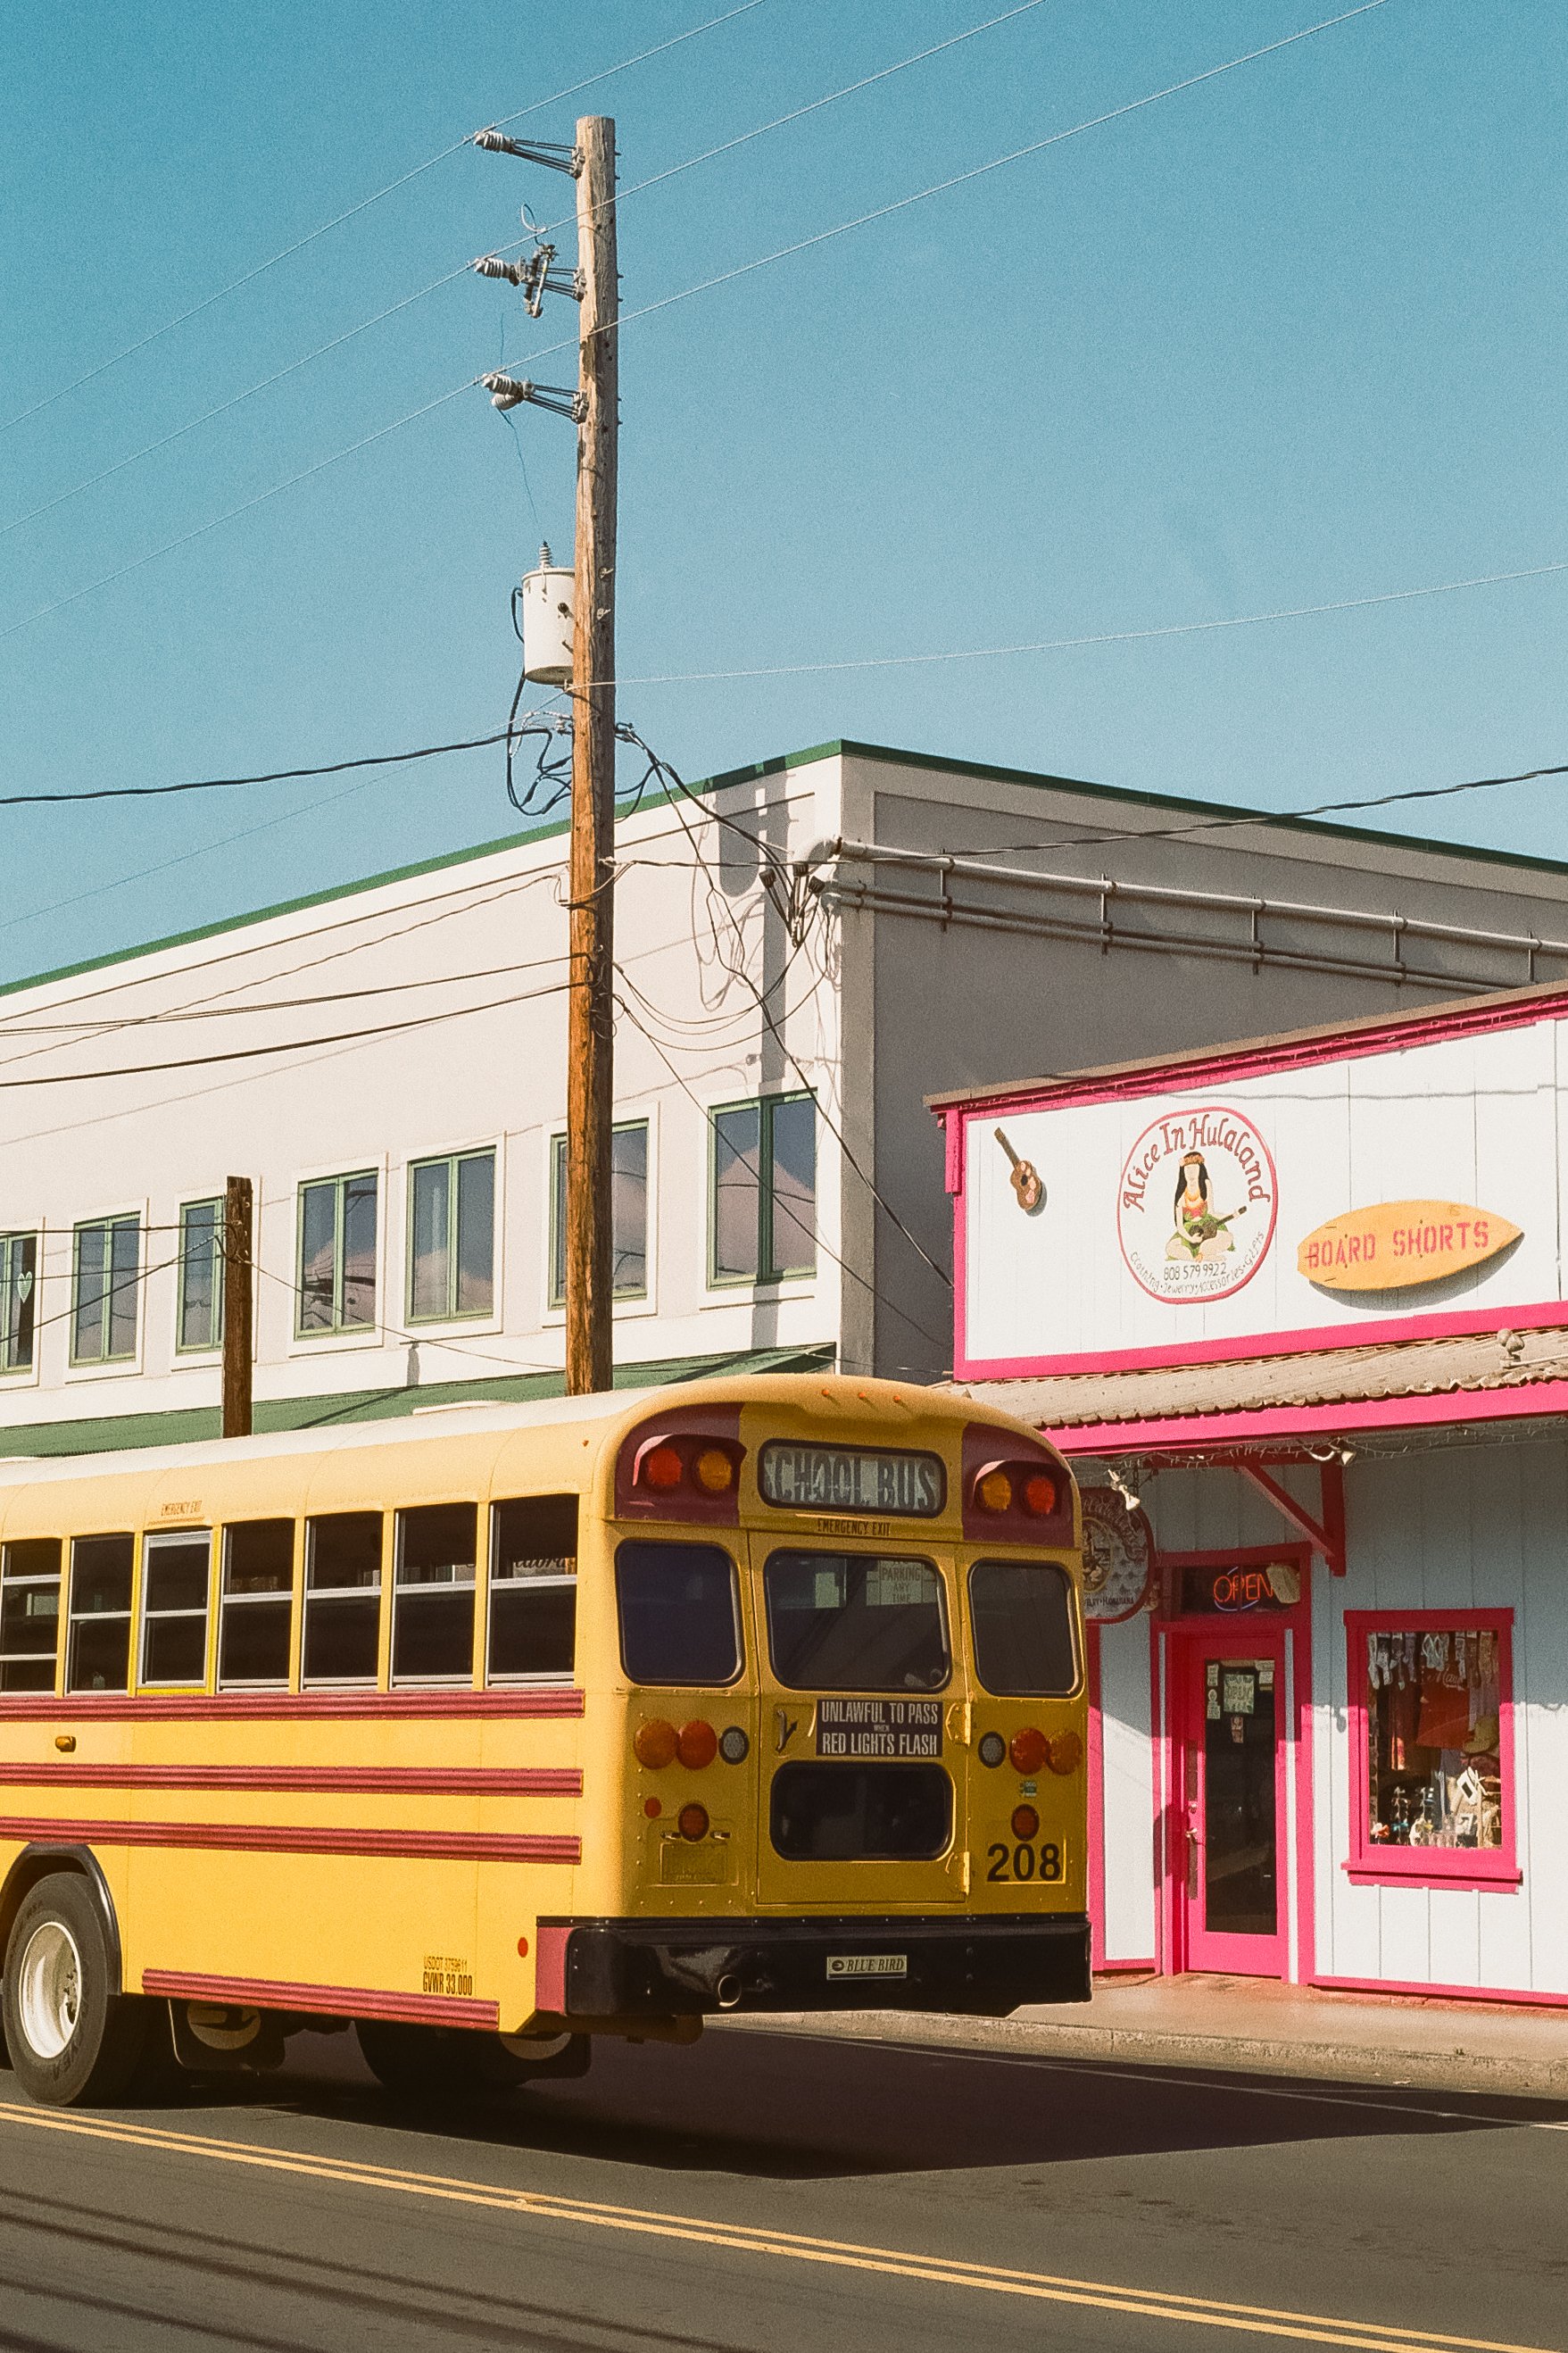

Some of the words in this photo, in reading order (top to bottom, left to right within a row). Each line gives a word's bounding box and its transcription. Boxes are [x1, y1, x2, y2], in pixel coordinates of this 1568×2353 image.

[1124, 1143, 1161, 1213] Alice
[1159, 1122, 1187, 1155] In
[1189, 1113, 1271, 1203] Hulaland
[1307, 1232, 1376, 1269] BOARD
[1392, 1220, 1489, 1257] SHORTS
[1164, 1265, 1181, 1281] 808
[1183, 1264, 1201, 1279] 579
[1202, 1262, 1227, 1277] 9922
[877, 1457, 937, 1510] BUS
[817, 1518, 869, 1536] EMERGENCY
[872, 1521, 891, 1537] EXIT
[881, 1567, 921, 1582] PARKING
[1214, 1573, 1274, 1603] OPEN
[821, 1700, 886, 1724] UNLAWFUL
[889, 1702, 904, 1724] TO
[908, 1702, 938, 1725] PASS
[873, 1725, 890, 1733] WHEN
[822, 1733, 847, 1754] RED
[850, 1734, 895, 1755] LIGHTS
[899, 1734, 937, 1756] FLASH
[986, 1843, 1061, 1883] 208
[847, 1958, 875, 1973] BLUE
[877, 1958, 904, 1972] BIRD
[423, 1971, 444, 1993] GVWR
